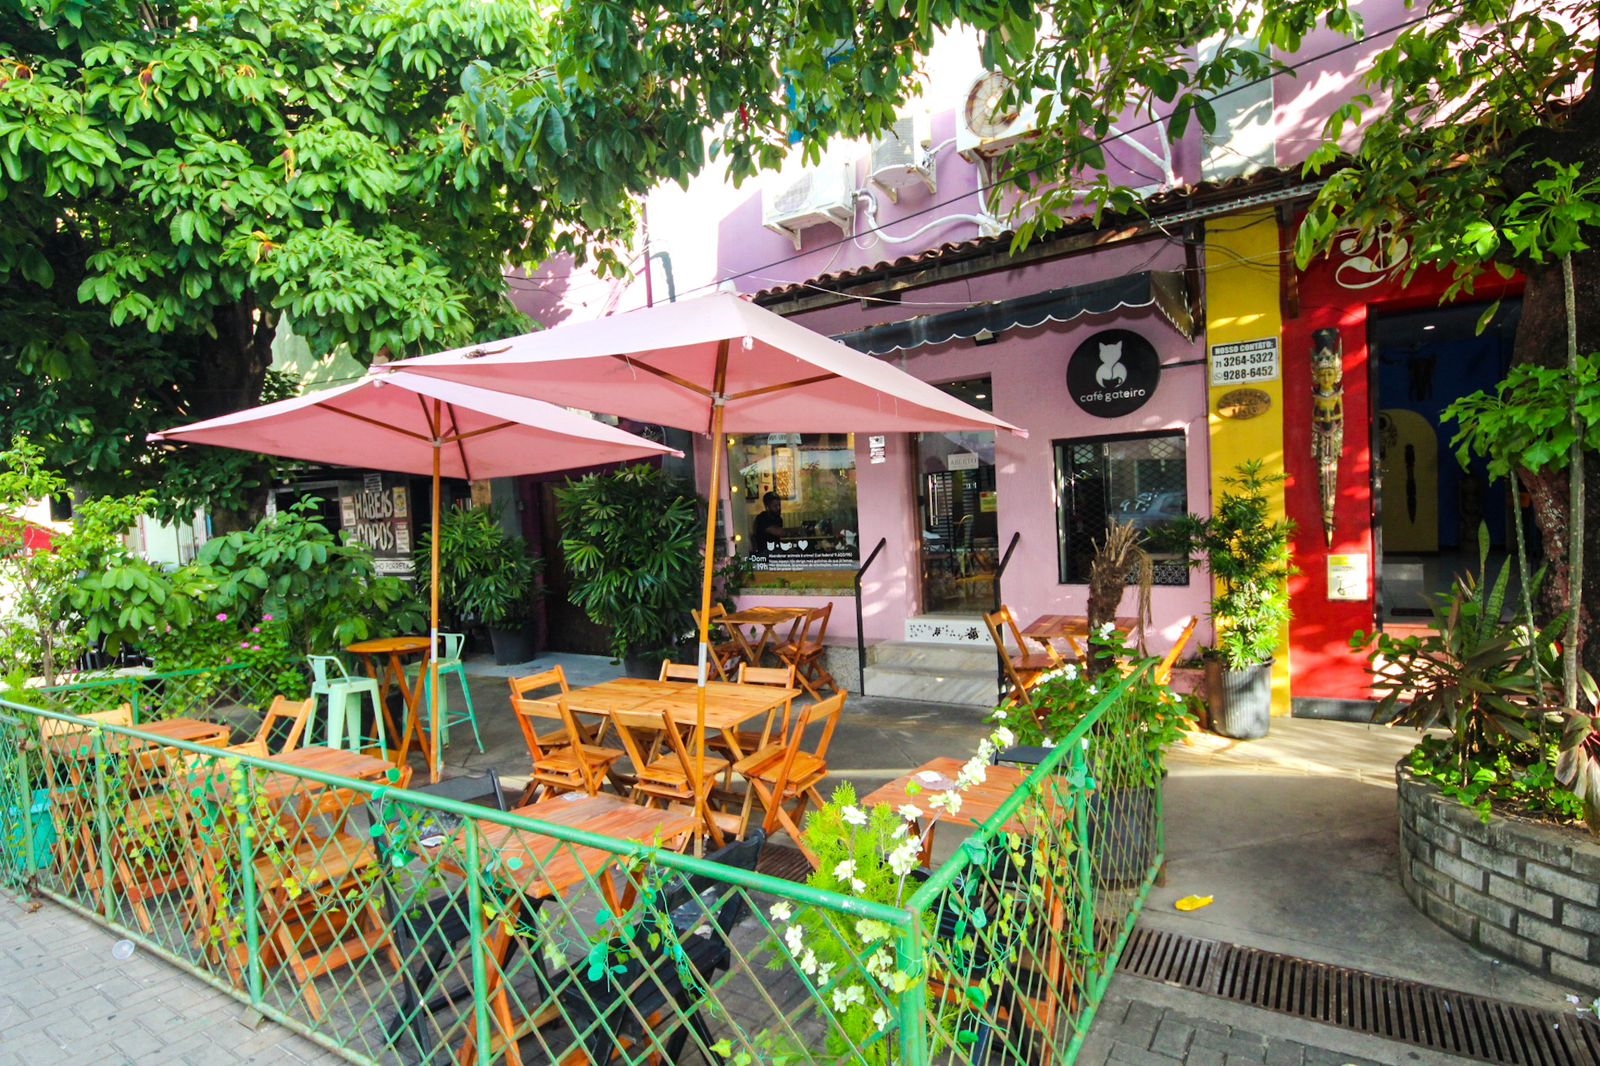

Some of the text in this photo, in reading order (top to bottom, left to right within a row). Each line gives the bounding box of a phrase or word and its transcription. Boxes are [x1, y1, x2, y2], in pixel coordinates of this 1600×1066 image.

[1214, 340, 1274, 355] NOSSO CONTATO:
[1223, 351, 1274, 367] 3264-5322
[1223, 366, 1274, 381] 9288-6452
[1080, 387, 1146, 403] café gateiro
[354, 490, 393, 519] HABEAS
[357, 521, 394, 552] COPOS
